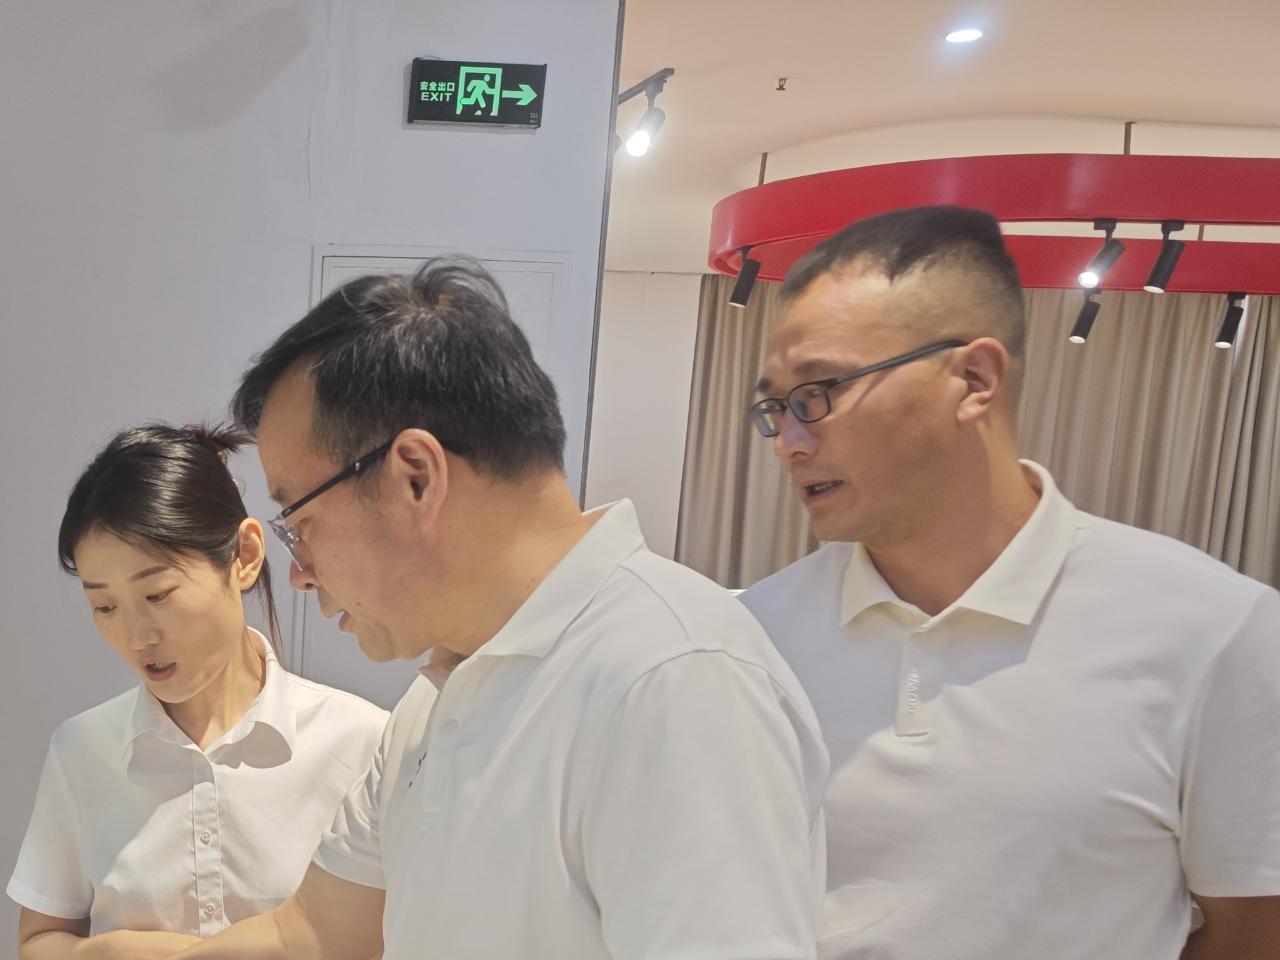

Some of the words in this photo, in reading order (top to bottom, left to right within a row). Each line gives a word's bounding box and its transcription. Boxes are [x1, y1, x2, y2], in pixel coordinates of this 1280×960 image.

[420, 81, 455, 92] 安全出口
[421, 92, 452, 102] EXIT
